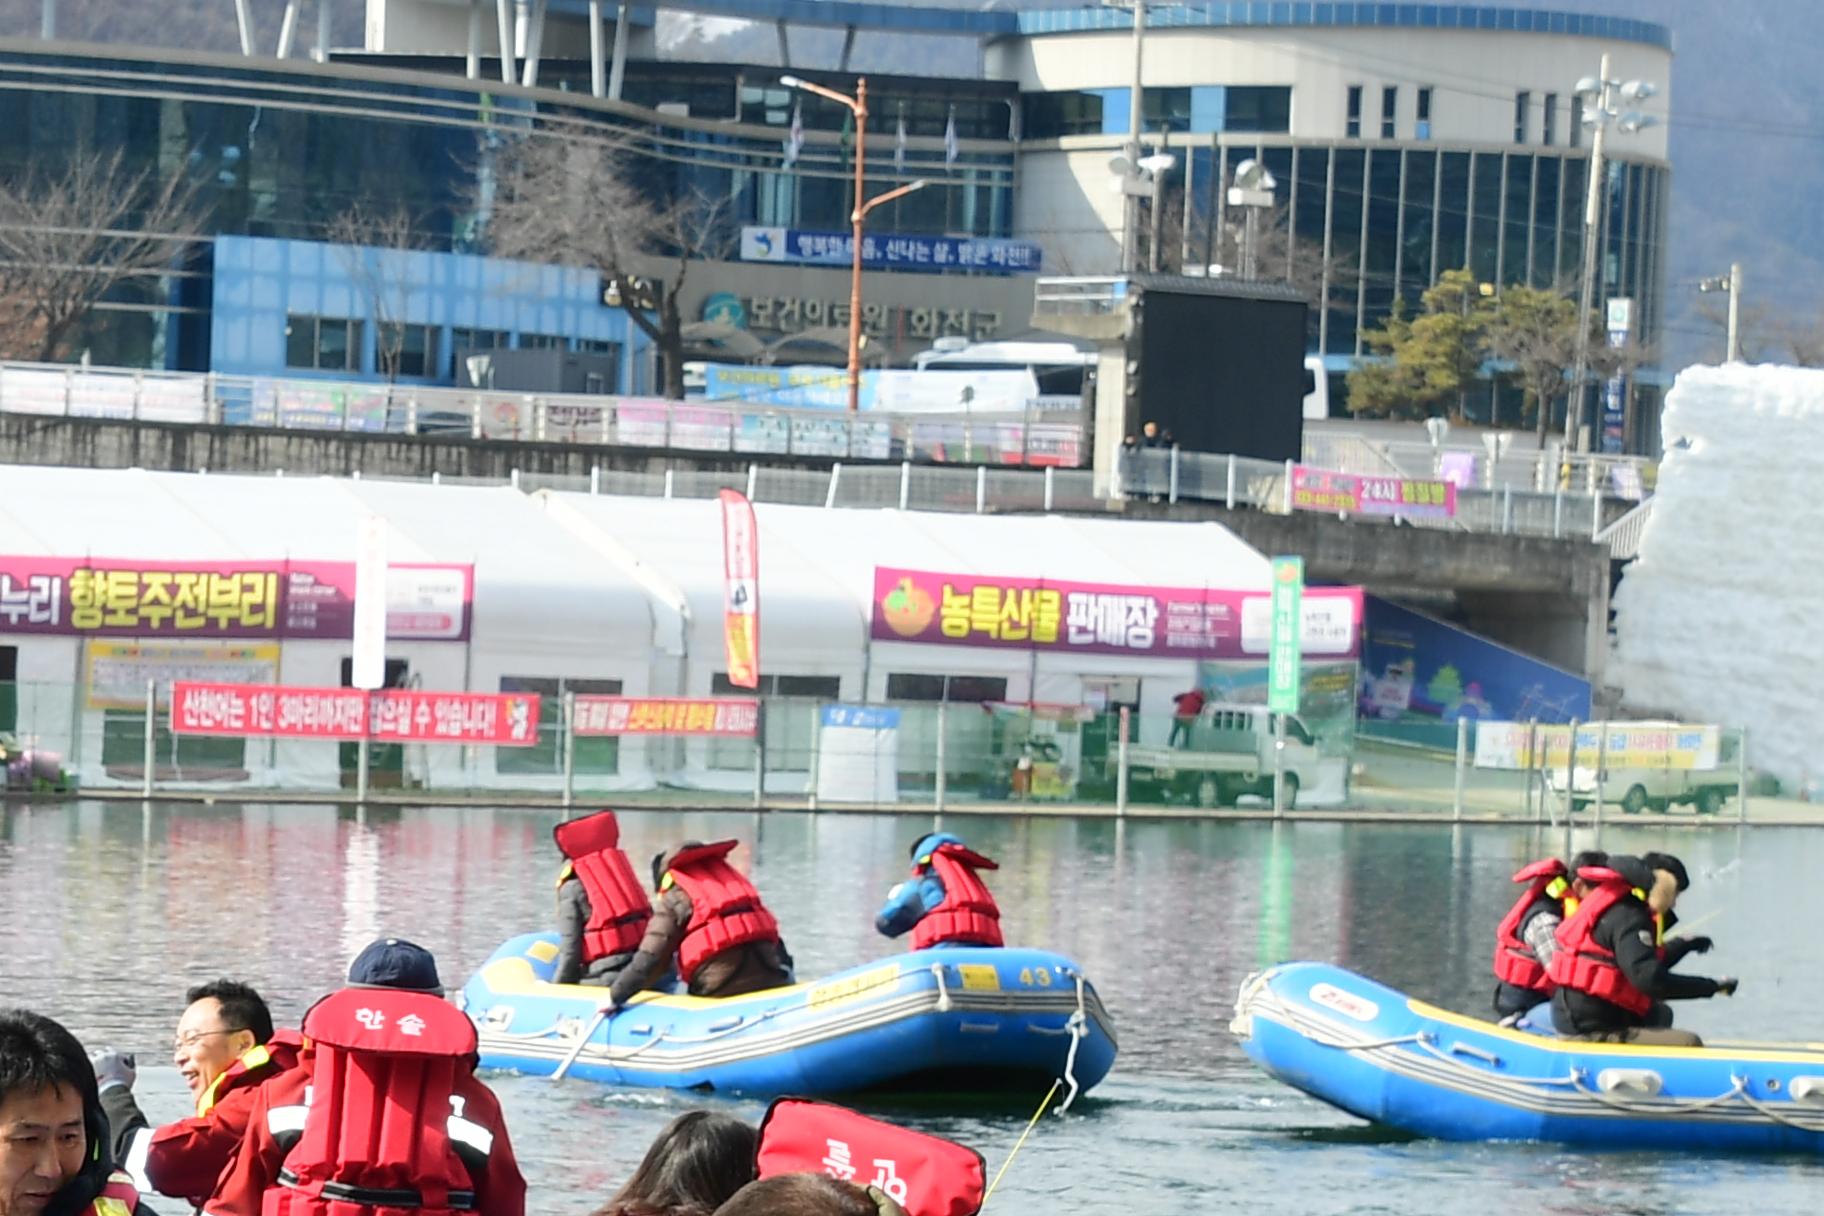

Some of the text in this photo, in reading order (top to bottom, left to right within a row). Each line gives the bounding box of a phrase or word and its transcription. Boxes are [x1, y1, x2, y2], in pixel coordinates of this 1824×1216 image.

[69, 568, 278, 630] 향토주전부리
[940, 583, 1061, 643] 농특산물
[1065, 591, 1159, 649] 판매장
[182, 687, 246, 729] 산천어는
[1018, 967, 1052, 987] 43
[355, 1007, 426, 1037] 한솔
